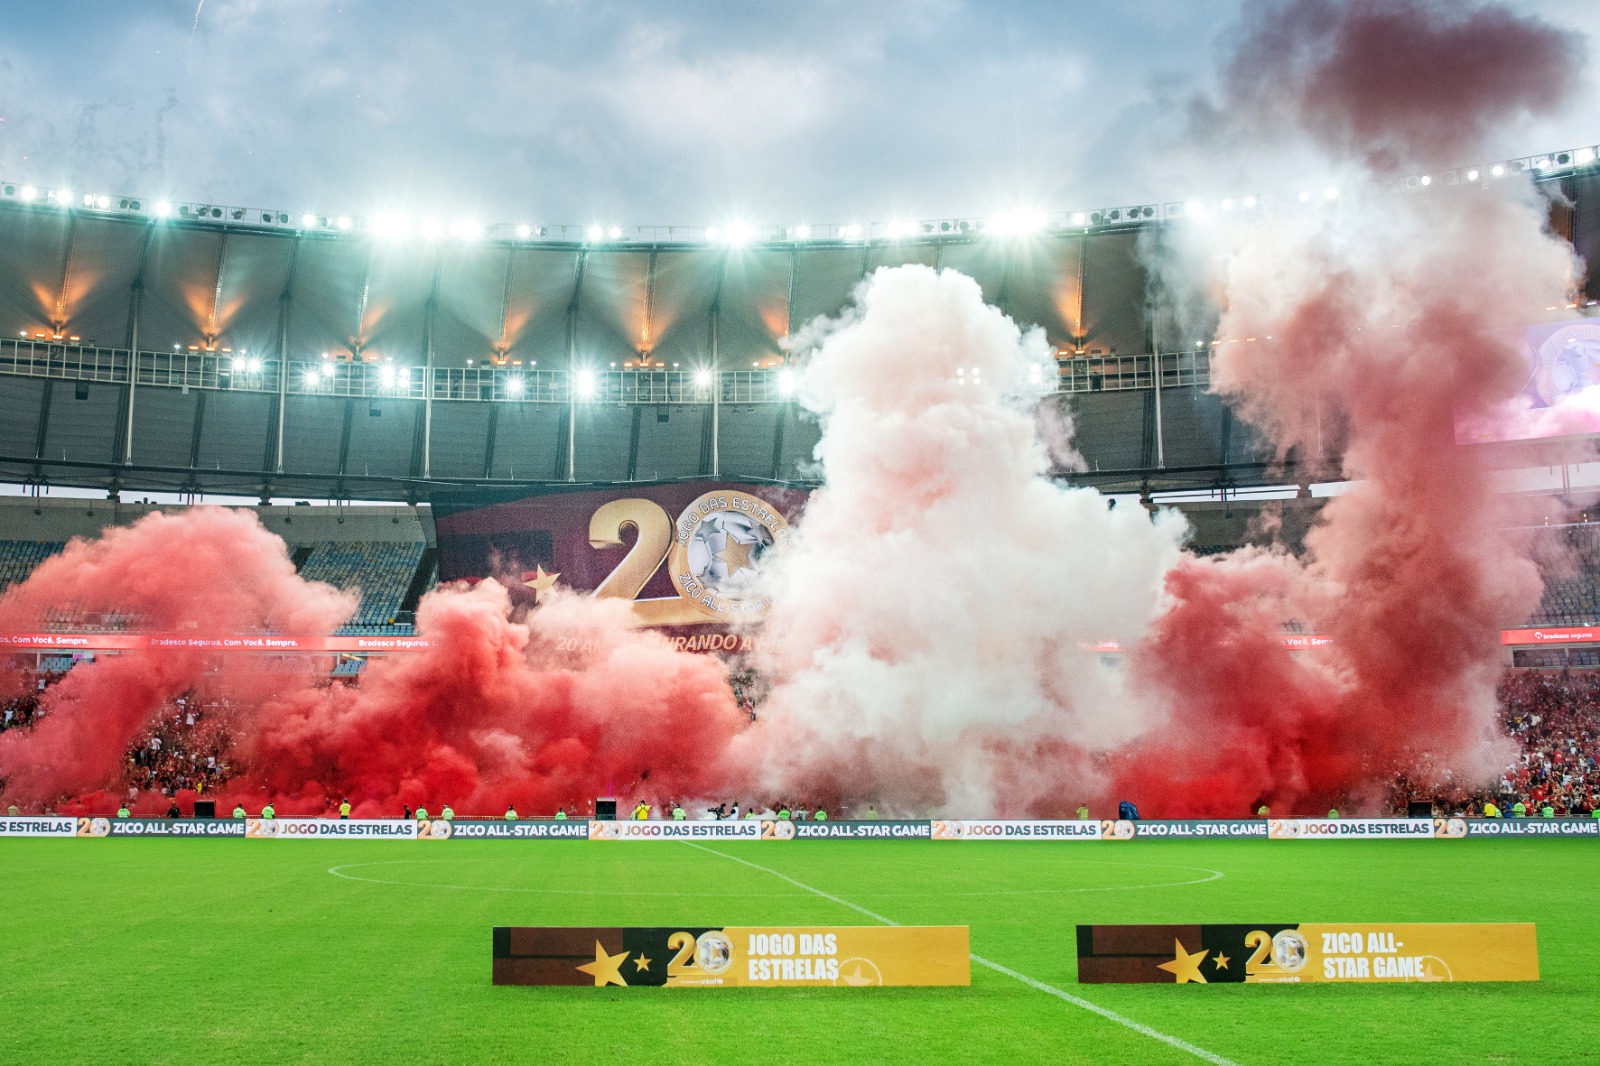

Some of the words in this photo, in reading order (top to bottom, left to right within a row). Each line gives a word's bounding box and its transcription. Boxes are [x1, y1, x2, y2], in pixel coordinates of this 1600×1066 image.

[677, 512, 700, 547] JOGO
[699, 497, 728, 515] DAS
[679, 572, 702, 599] ZICO
[12, 636, 31, 644] Com
[32, 635, 55, 645] Você.
[56, 636, 90, 646] Sempre.
[1543, 632, 1570, 640] bradesco
[151, 638, 187, 646] Bradesco
[188, 638, 223, 648] Seguros.
[223, 639, 242, 647] Com
[243, 638, 265, 647] Você.
[265, 639, 298, 648] Sempre.
[358, 639, 395, 647] Bradesco
[9, 821, 72, 833] ESTRELAS
[113, 822, 144, 834] ZICO
[145, 822, 206, 834] ALL-STAR
[207, 822, 244, 834] GAME
[281, 823, 318, 835] JOGO
[320, 823, 347, 835] DAS
[349, 823, 412, 835] ESTRELAS
[454, 824, 485, 836] ZICO
[486, 824, 548, 836] ALL-STAR
[549, 824, 587, 836] GAME
[624, 824, 661, 836] JOGO
[663, 824, 690, 836] DAS
[692, 824, 756, 836] ESTRELAS
[798, 825, 829, 837] ZICO
[829, 825, 891, 837] ALL-STAR
[892, 825, 929, 837] GAME
[967, 824, 1002, 836] JOGO
[1005, 824, 1031, 836] DAS
[1033, 824, 1096, 836] ESTRELAS
[1137, 824, 1168, 835] ZICO
[1168, 824, 1228, 835] ALL-STAR
[1229, 824, 1266, 835] GAME
[1303, 823, 1338, 835] JOGO
[1340, 823, 1367, 835] DAS
[1368, 823, 1429, 835] ESTRELAS
[1470, 822, 1500, 834] ZICO
[1501, 822, 1560, 834] ALL-STAR
[1560, 822, 1598, 834] GAME
[747, 933, 795, 955] JOGO
[799, 933, 838, 955] DAS
[1321, 932, 1364, 954] ZICO
[1367, 932, 1404, 953] ALL-
[748, 958, 839, 980] ESTRELAS
[1323, 957, 1370, 979] STAR
[1373, 956, 1425, 978] GAME
